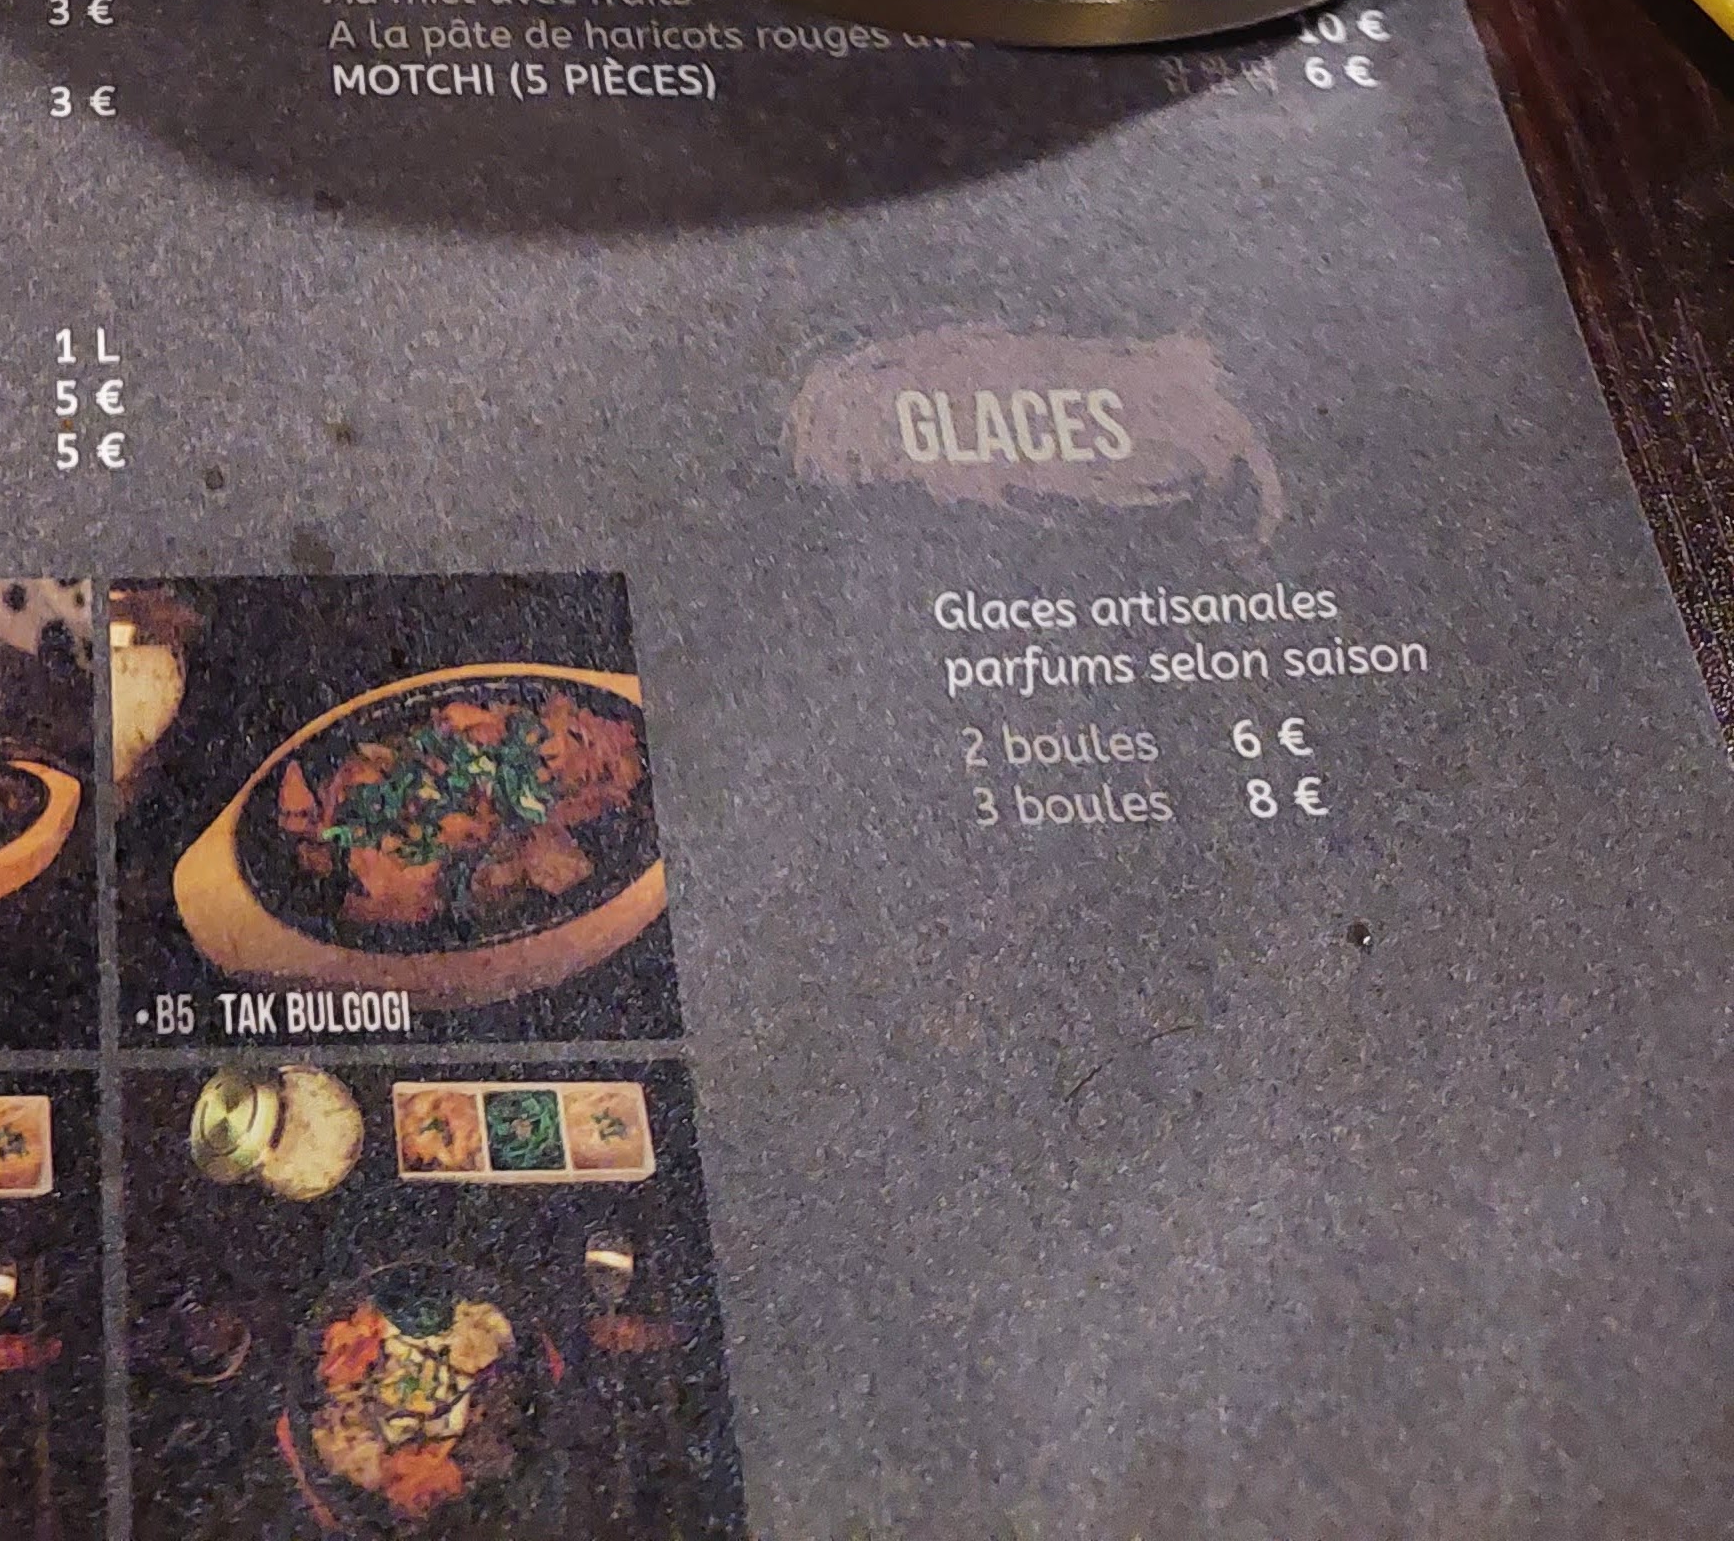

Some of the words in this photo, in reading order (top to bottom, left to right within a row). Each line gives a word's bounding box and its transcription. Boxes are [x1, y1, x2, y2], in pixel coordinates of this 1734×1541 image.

[328, 22, 356, 49] A
[370, 21, 409, 50] la
[423, 20, 511, 59] pâte
[526, 21, 573, 50] de
[585, 20, 743, 52] haricots
[756, 24, 891, 58] rouges
[1357, 9, 1391, 42] €
[333, 65, 494, 97] MOTCHI
[510, 64, 548, 101] (5
[565, 56, 718, 101] PIÈCES)
[1304, 56, 1335, 90] 6
[1343, 55, 1379, 88] €
[49, 87, 72, 117] 3
[89, 86, 117, 116] €
[56, 330, 76, 363] 1
[97, 329, 121, 363] L
[56, 383, 78, 417] 5
[96, 381, 125, 416] €
[897, 389, 1133, 465] GLACES
[56, 435, 79, 469] 5
[96, 434, 127, 469] €
[934, 589, 1076, 630] Glaces
[1092, 583, 1337, 627] artisanales
[946, 648, 1135, 698] parfums
[1150, 644, 1268, 683] selon
[1284, 640, 1428, 679] saison
[963, 728, 987, 765] 2
[1004, 723, 1159, 764] boules
[1232, 720, 1261, 758] 6
[1278, 718, 1313, 757] €
[974, 787, 998, 824] 3
[1015, 783, 1173, 823] boules
[1248, 781, 1278, 819] 8
[1293, 777, 1329, 817] €
[156, 994, 195, 1035] B5
[219, 992, 279, 1035] TAK
[287, 990, 411, 1035] BULGOGI
